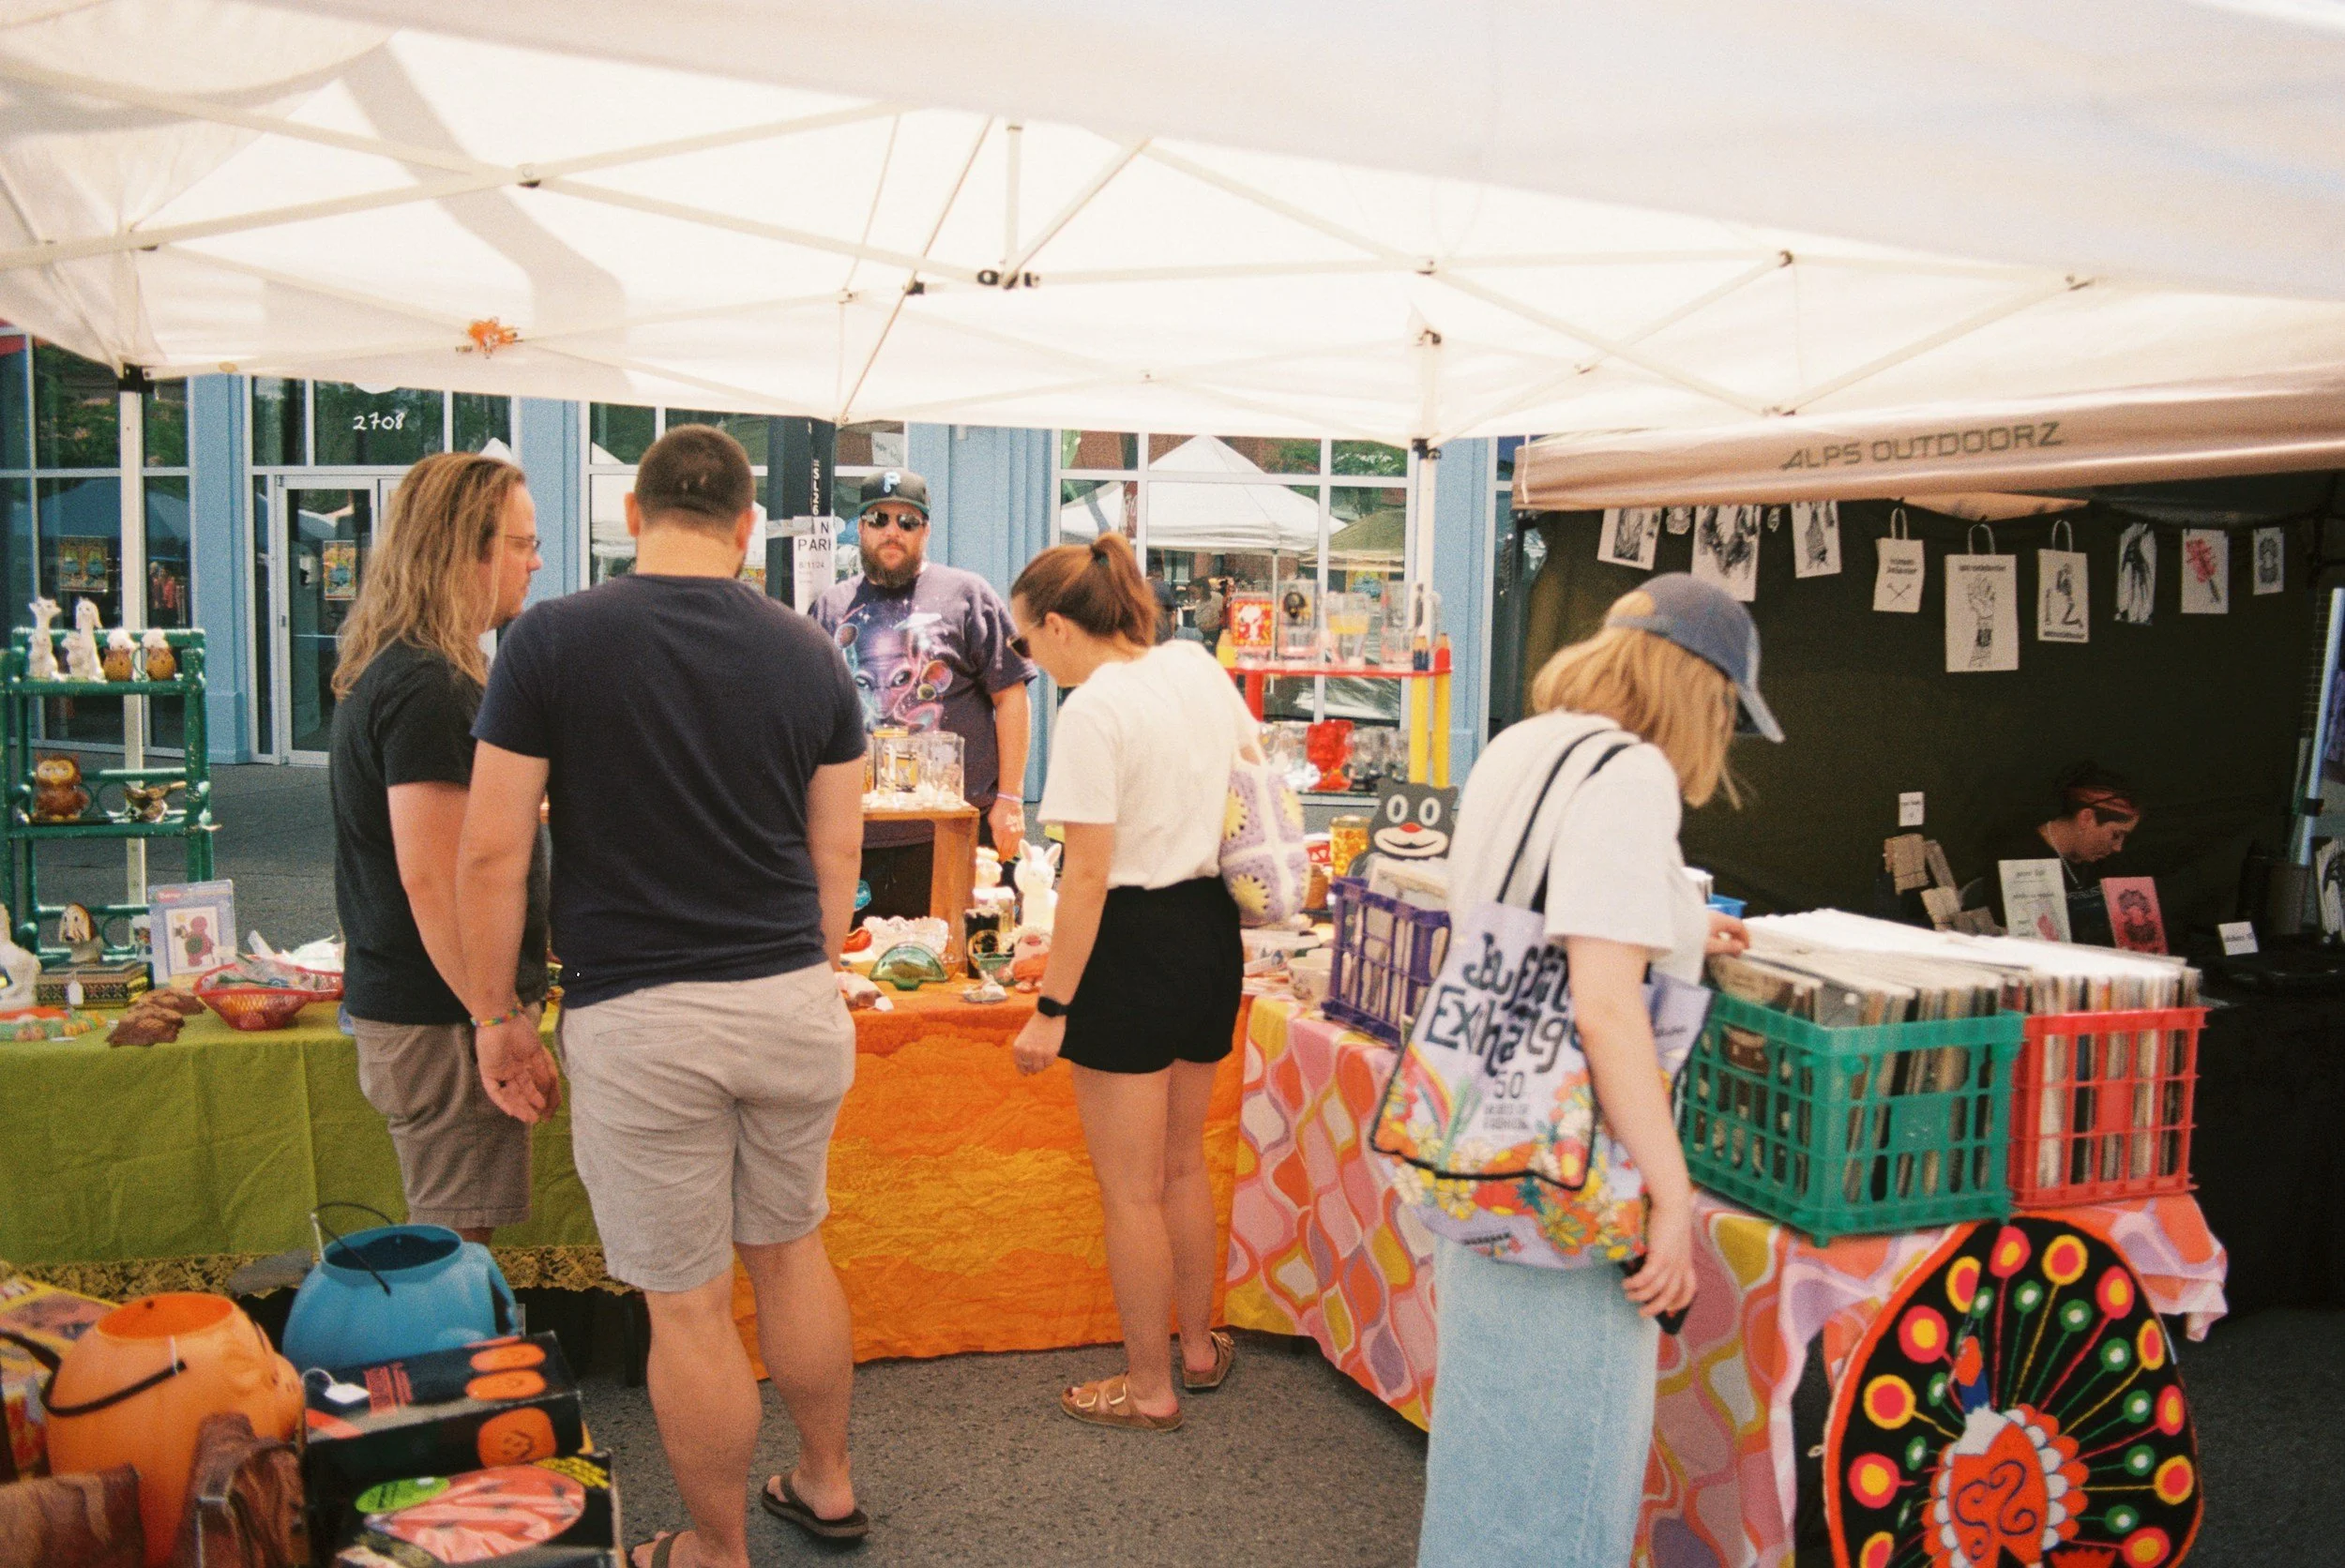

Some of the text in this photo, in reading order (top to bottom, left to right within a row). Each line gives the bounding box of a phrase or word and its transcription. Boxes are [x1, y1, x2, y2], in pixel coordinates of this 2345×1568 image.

[353, 412, 405, 430] 2708
[1779, 420, 2064, 471] ALPS OUTDOORZ
[1493, 1070, 1524, 1098] 50
